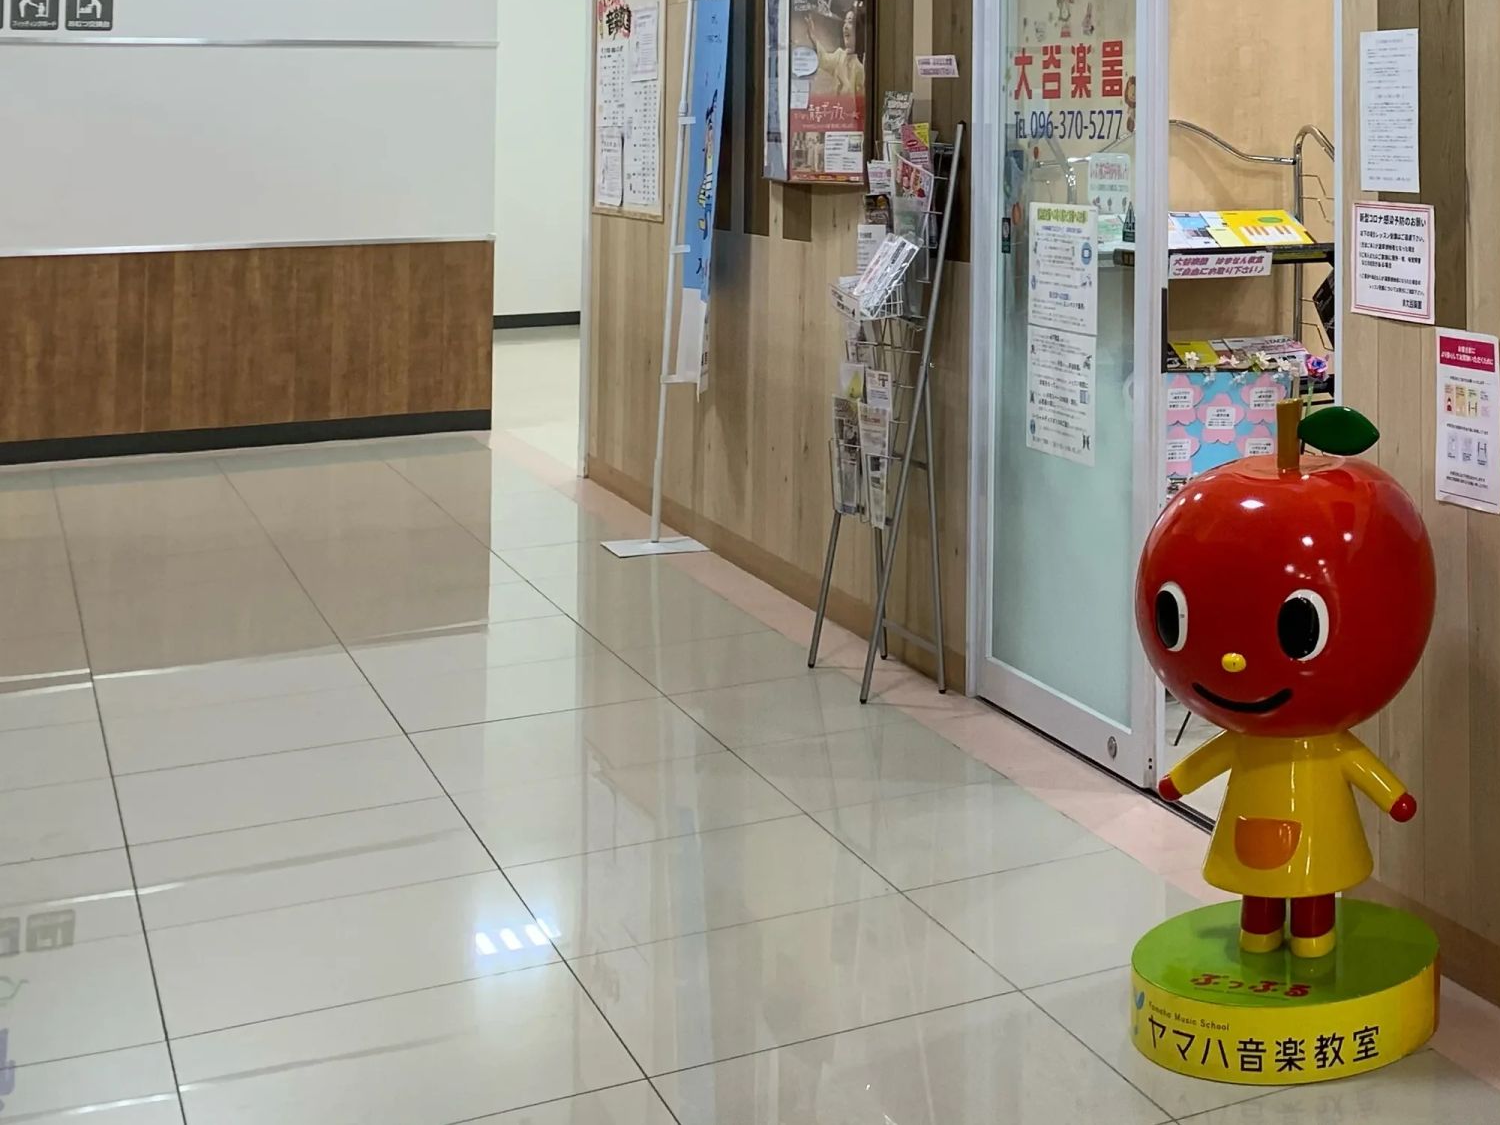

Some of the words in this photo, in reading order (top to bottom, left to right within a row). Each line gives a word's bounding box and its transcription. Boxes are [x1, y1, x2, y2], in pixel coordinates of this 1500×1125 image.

[1013, 39, 1124, 100] 大谷楽器
[1030, 109, 1123, 140] 096-370-5277
[1174, 1012, 1197, 1028] Music
[1199, 1018, 1230, 1032] School
[1147, 1016, 1380, 1073] ヤマハ音楽教室
